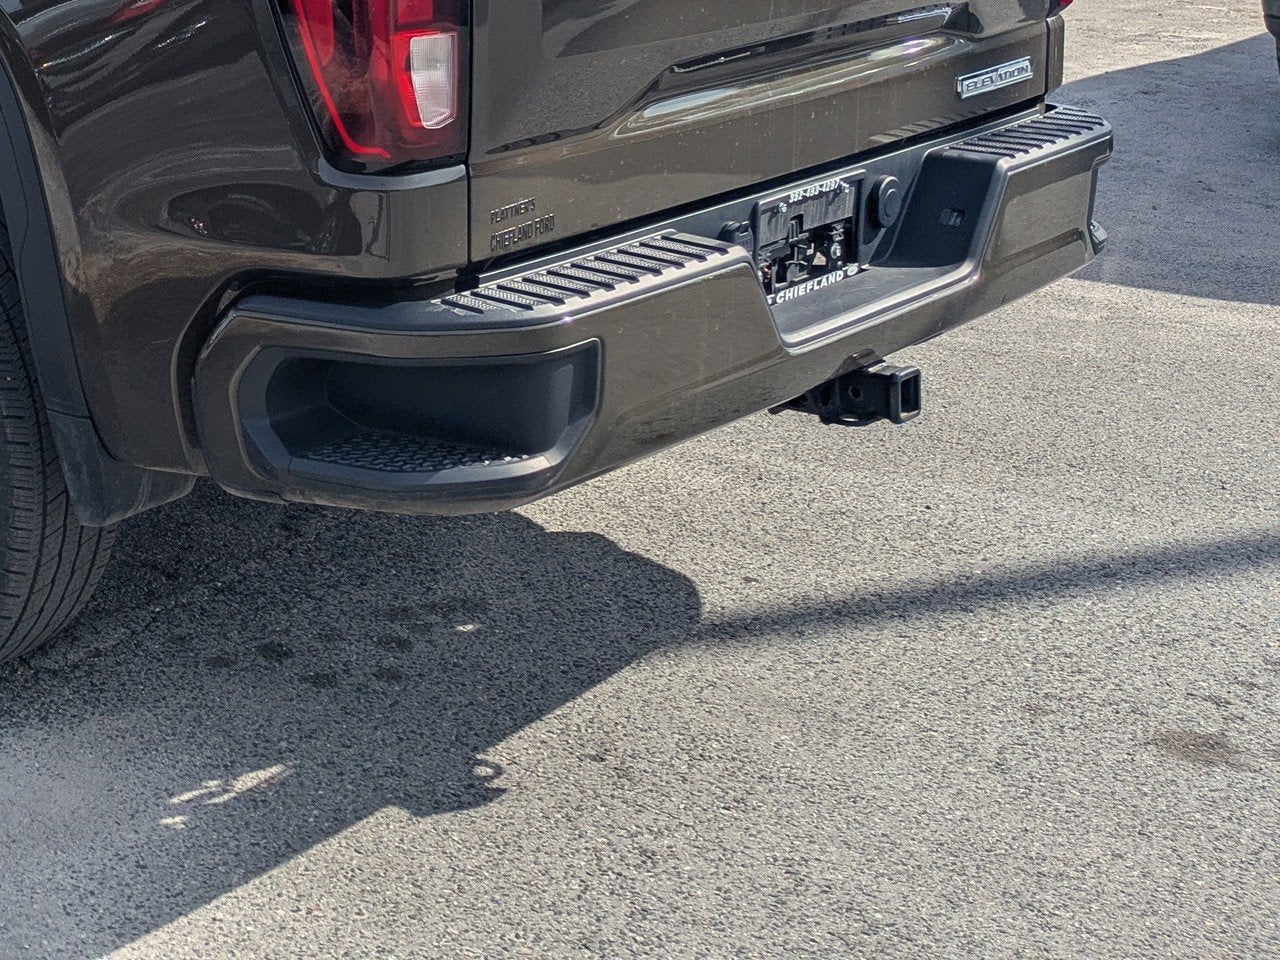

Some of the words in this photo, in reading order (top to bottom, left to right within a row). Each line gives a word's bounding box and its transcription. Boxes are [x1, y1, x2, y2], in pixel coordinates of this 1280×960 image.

[965, 63, 1030, 92] ELEVATION
[490, 221, 533, 252] CHIEFLAND
[534, 213, 555, 238] FORD
[775, 270, 845, 304] CHIEFLAND
